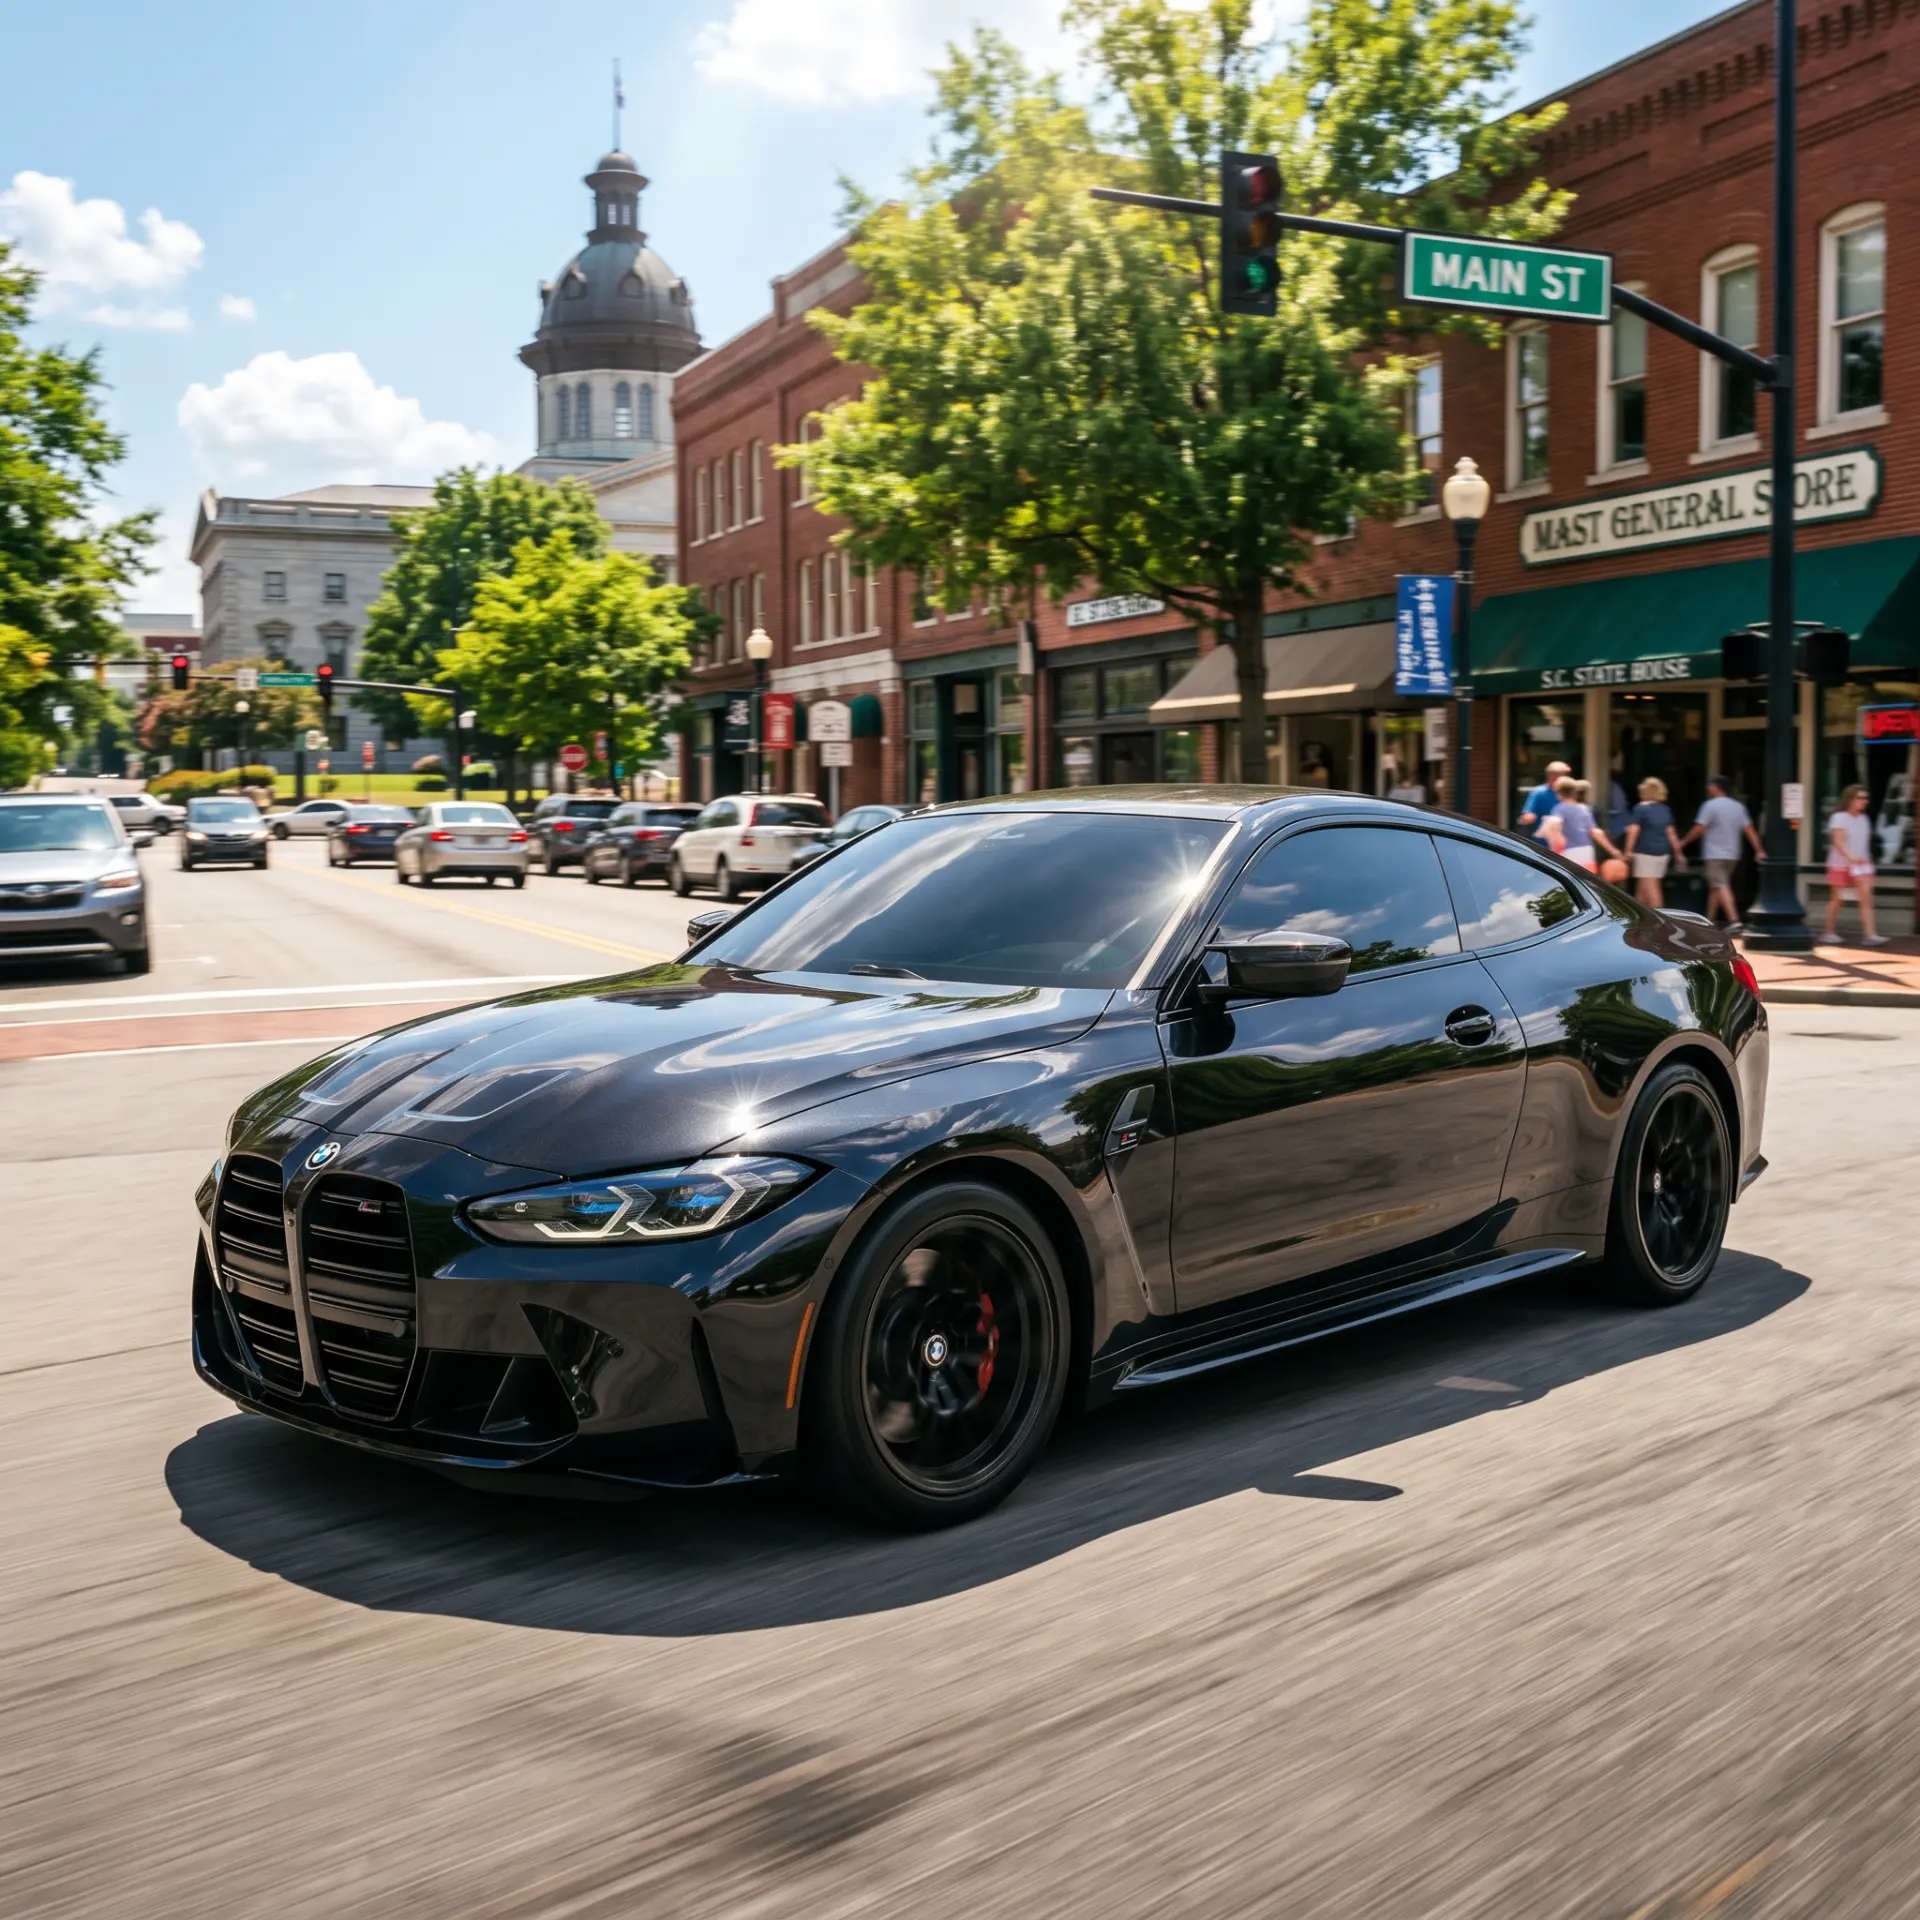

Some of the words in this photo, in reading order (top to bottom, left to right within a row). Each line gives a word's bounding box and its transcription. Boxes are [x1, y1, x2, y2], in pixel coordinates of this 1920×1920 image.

[1432, 252, 1527, 295] MAIN
[1541, 264, 1586, 302] ST
[1533, 510, 1603, 552] MAST
[1610, 486, 1744, 539] GENERAL
[1753, 464, 1857, 516] SORE
[1540, 669, 1571, 689] S.C.
[1573, 663, 1628, 687] STATE
[1630, 658, 1691, 682] HOUSE
